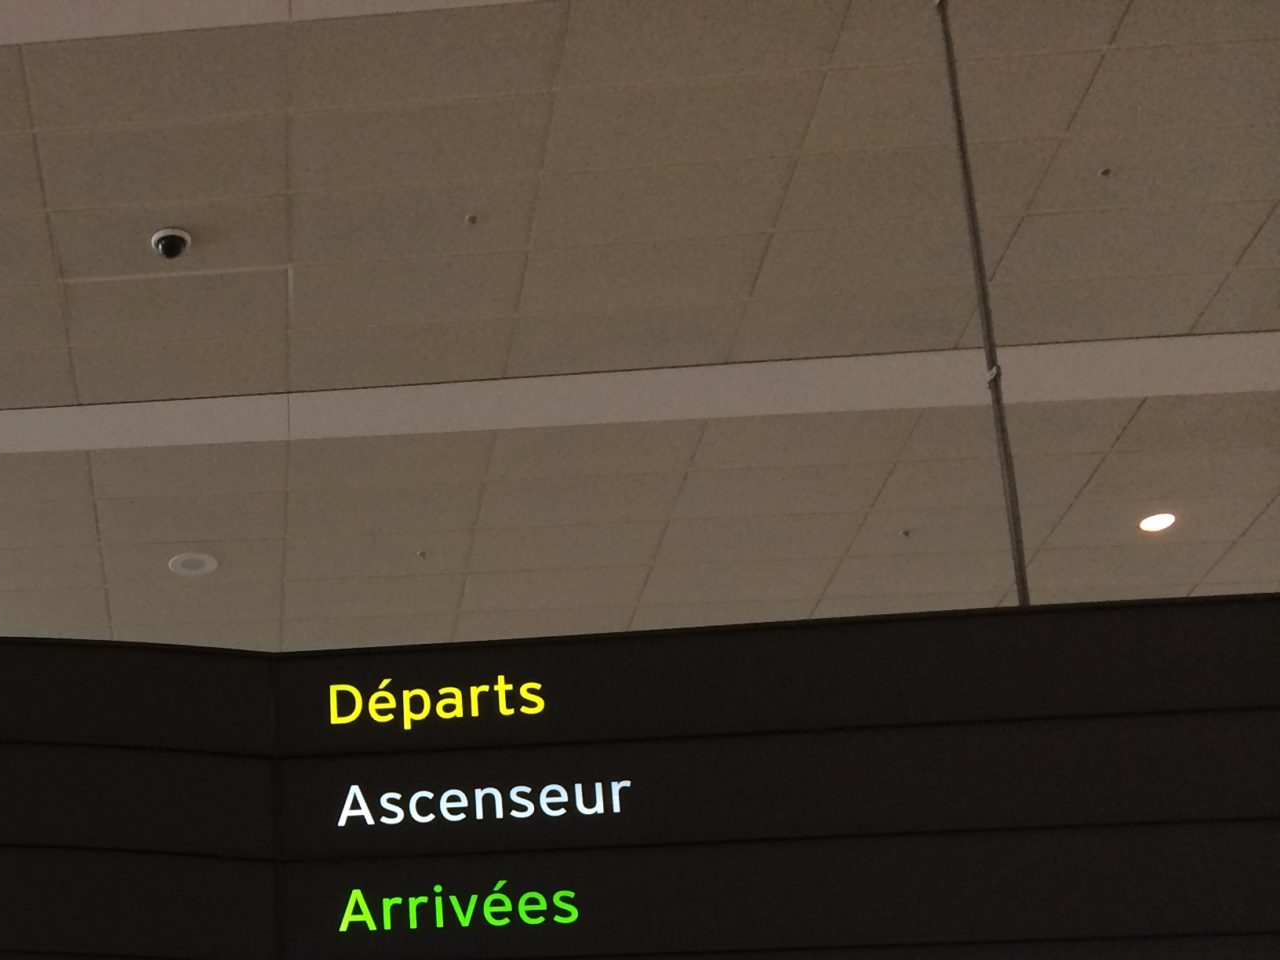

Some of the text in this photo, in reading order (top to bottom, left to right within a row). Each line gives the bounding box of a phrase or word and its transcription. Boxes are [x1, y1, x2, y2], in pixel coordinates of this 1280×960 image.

[330, 675, 546, 730] Départs
[338, 779, 632, 827] Ascenseur
[339, 880, 579, 932] Arrivées
